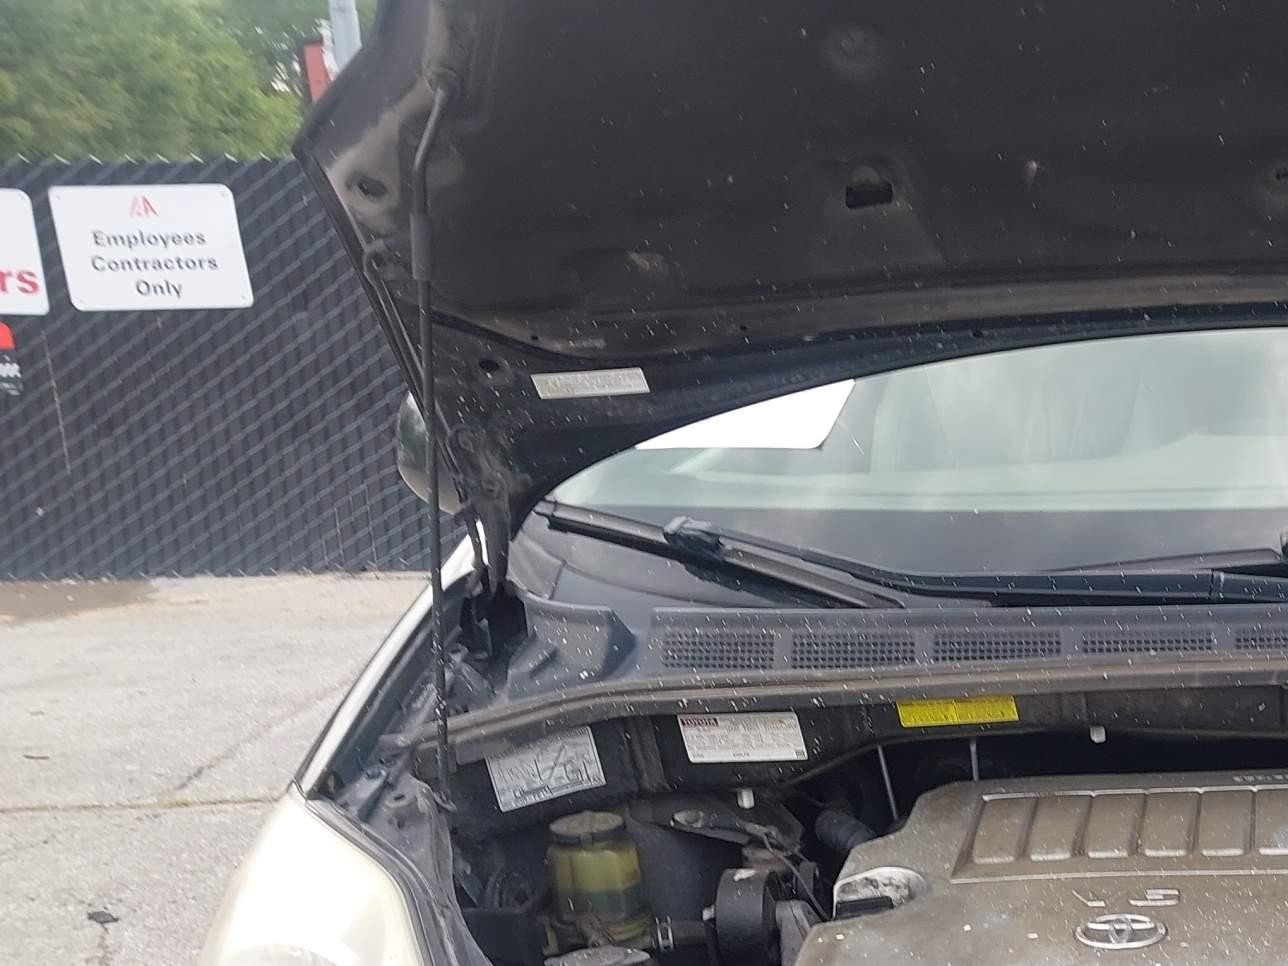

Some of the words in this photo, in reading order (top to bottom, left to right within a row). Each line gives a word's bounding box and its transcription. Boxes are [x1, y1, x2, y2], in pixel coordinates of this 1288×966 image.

[91, 229, 206, 250] Employees
[91, 255, 219, 272] Contractors
[135, 279, 182, 299] Only
